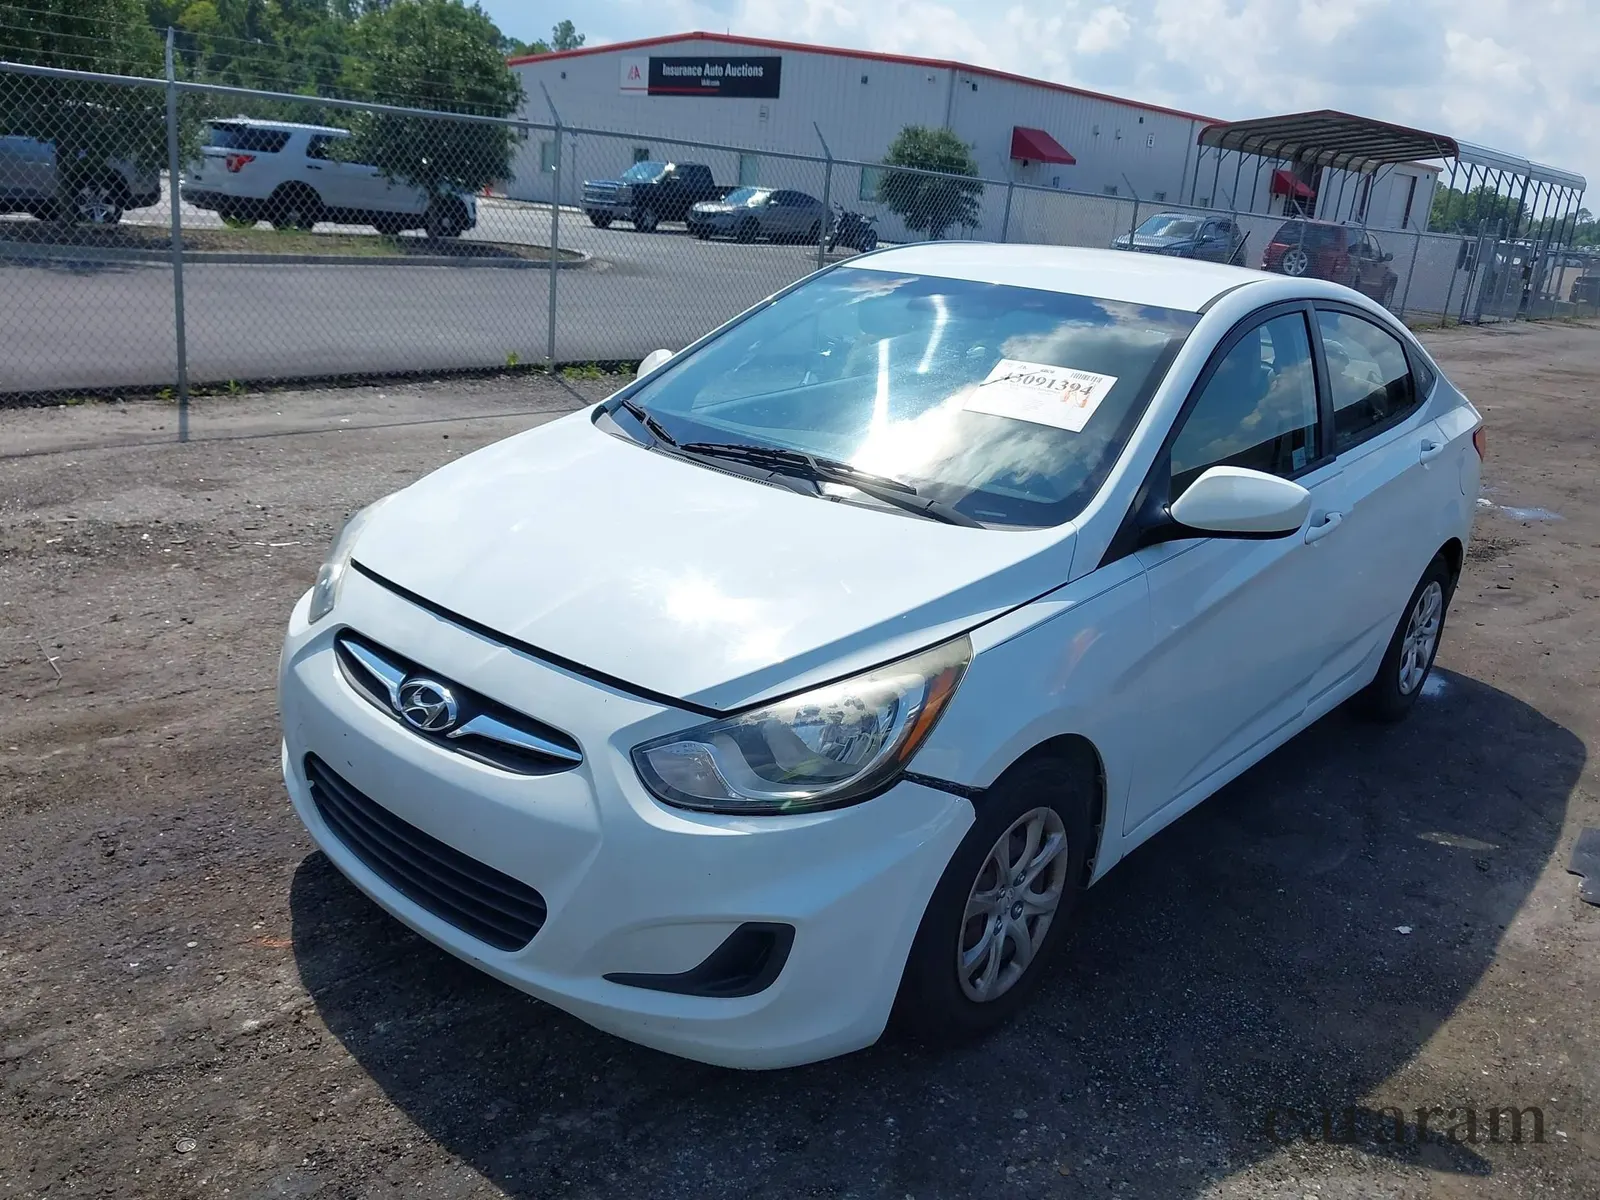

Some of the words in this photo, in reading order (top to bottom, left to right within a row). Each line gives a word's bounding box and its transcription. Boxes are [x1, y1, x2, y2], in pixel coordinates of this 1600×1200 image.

[662, 63, 702, 77] Insurance
[703, 63, 724, 77] Auto
[725, 63, 764, 77] Auctions
